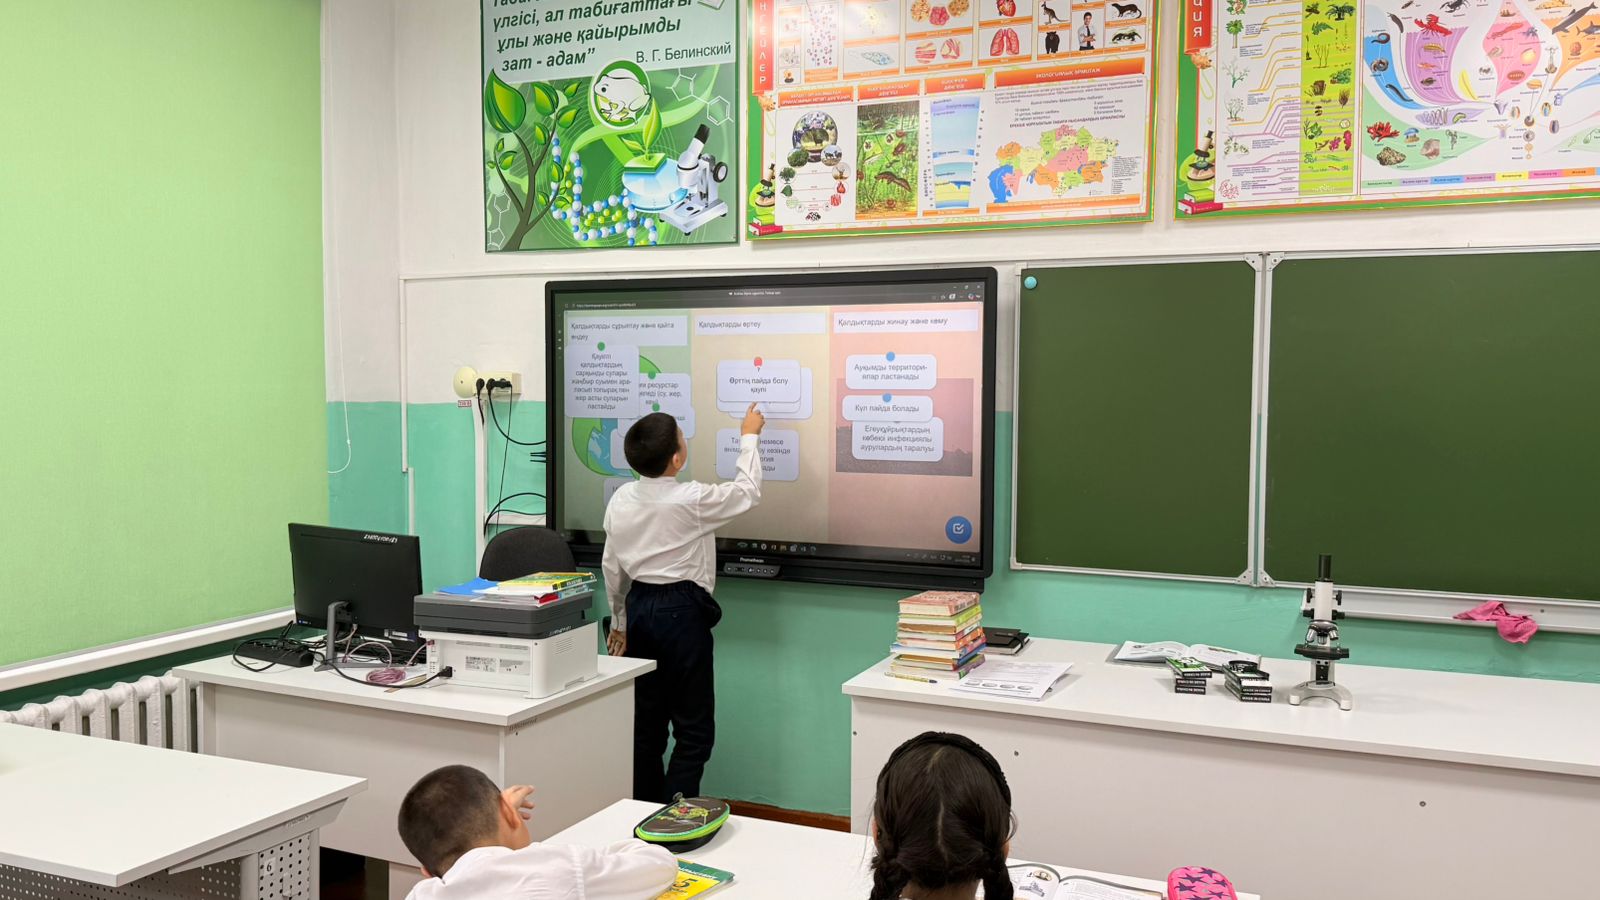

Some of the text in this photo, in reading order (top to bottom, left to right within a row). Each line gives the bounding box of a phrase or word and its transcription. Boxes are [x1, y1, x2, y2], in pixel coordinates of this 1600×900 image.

[493, 9, 540, 32] үлгісі,
[544, 9, 564, 22] ал
[496, 16, 681, 53] ұлы және қайырымды
[636, 41, 731, 63] В. Г. Белинский
[501, 57, 532, 71] зат
[698, 320, 741, 328] Қалдықтарды
[838, 319, 886, 328] Қалдықтарды
[854, 364, 886, 372] Ауқымды
[729, 376, 750, 385] Өрттің
[772, 376, 788, 386] болу
[855, 404, 920, 413] Күл пайда болады
[266, 862, 272, 872] 6
